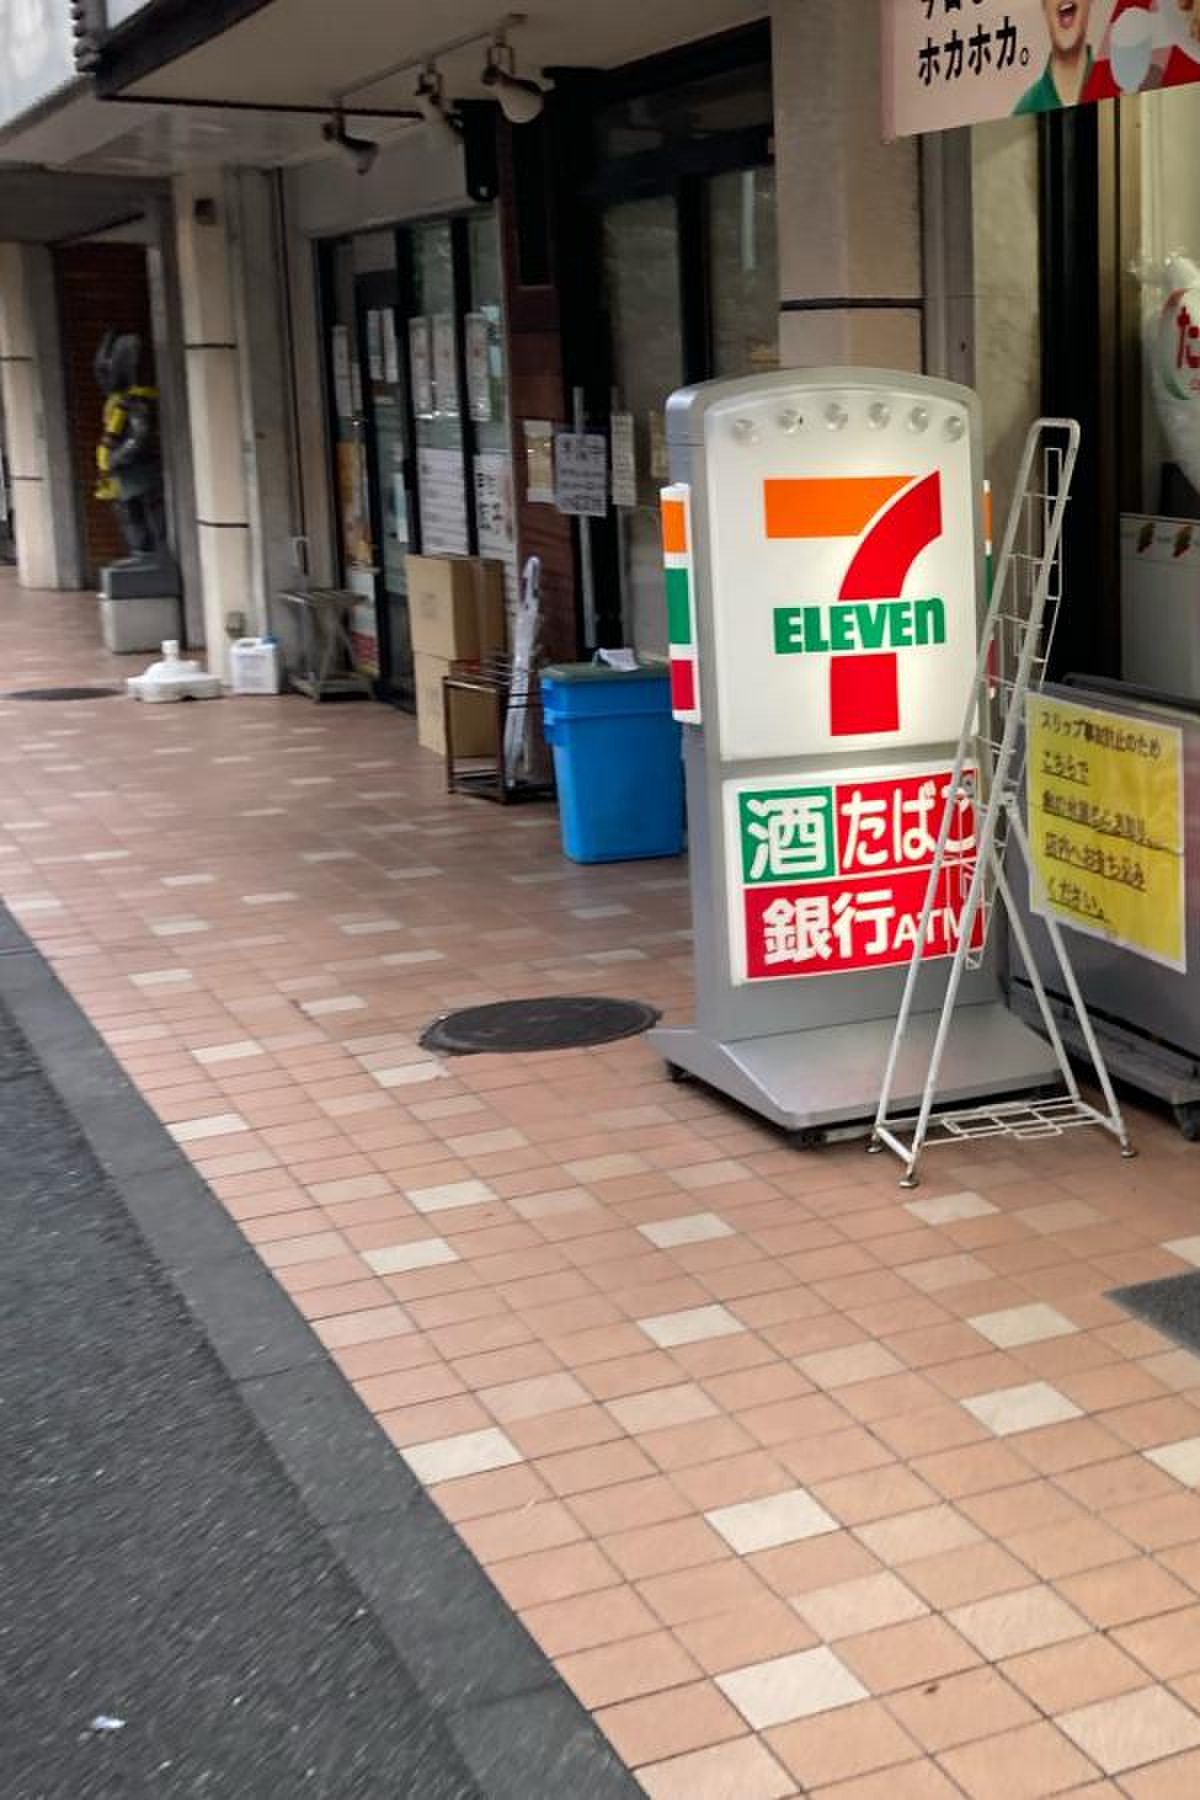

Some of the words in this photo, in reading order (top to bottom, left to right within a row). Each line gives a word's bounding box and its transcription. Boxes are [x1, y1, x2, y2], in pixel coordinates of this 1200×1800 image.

[918, 16, 1029, 86] ホカホカ。
[746, 795, 828, 880] 酒
[840, 781, 977, 869] たばこ
